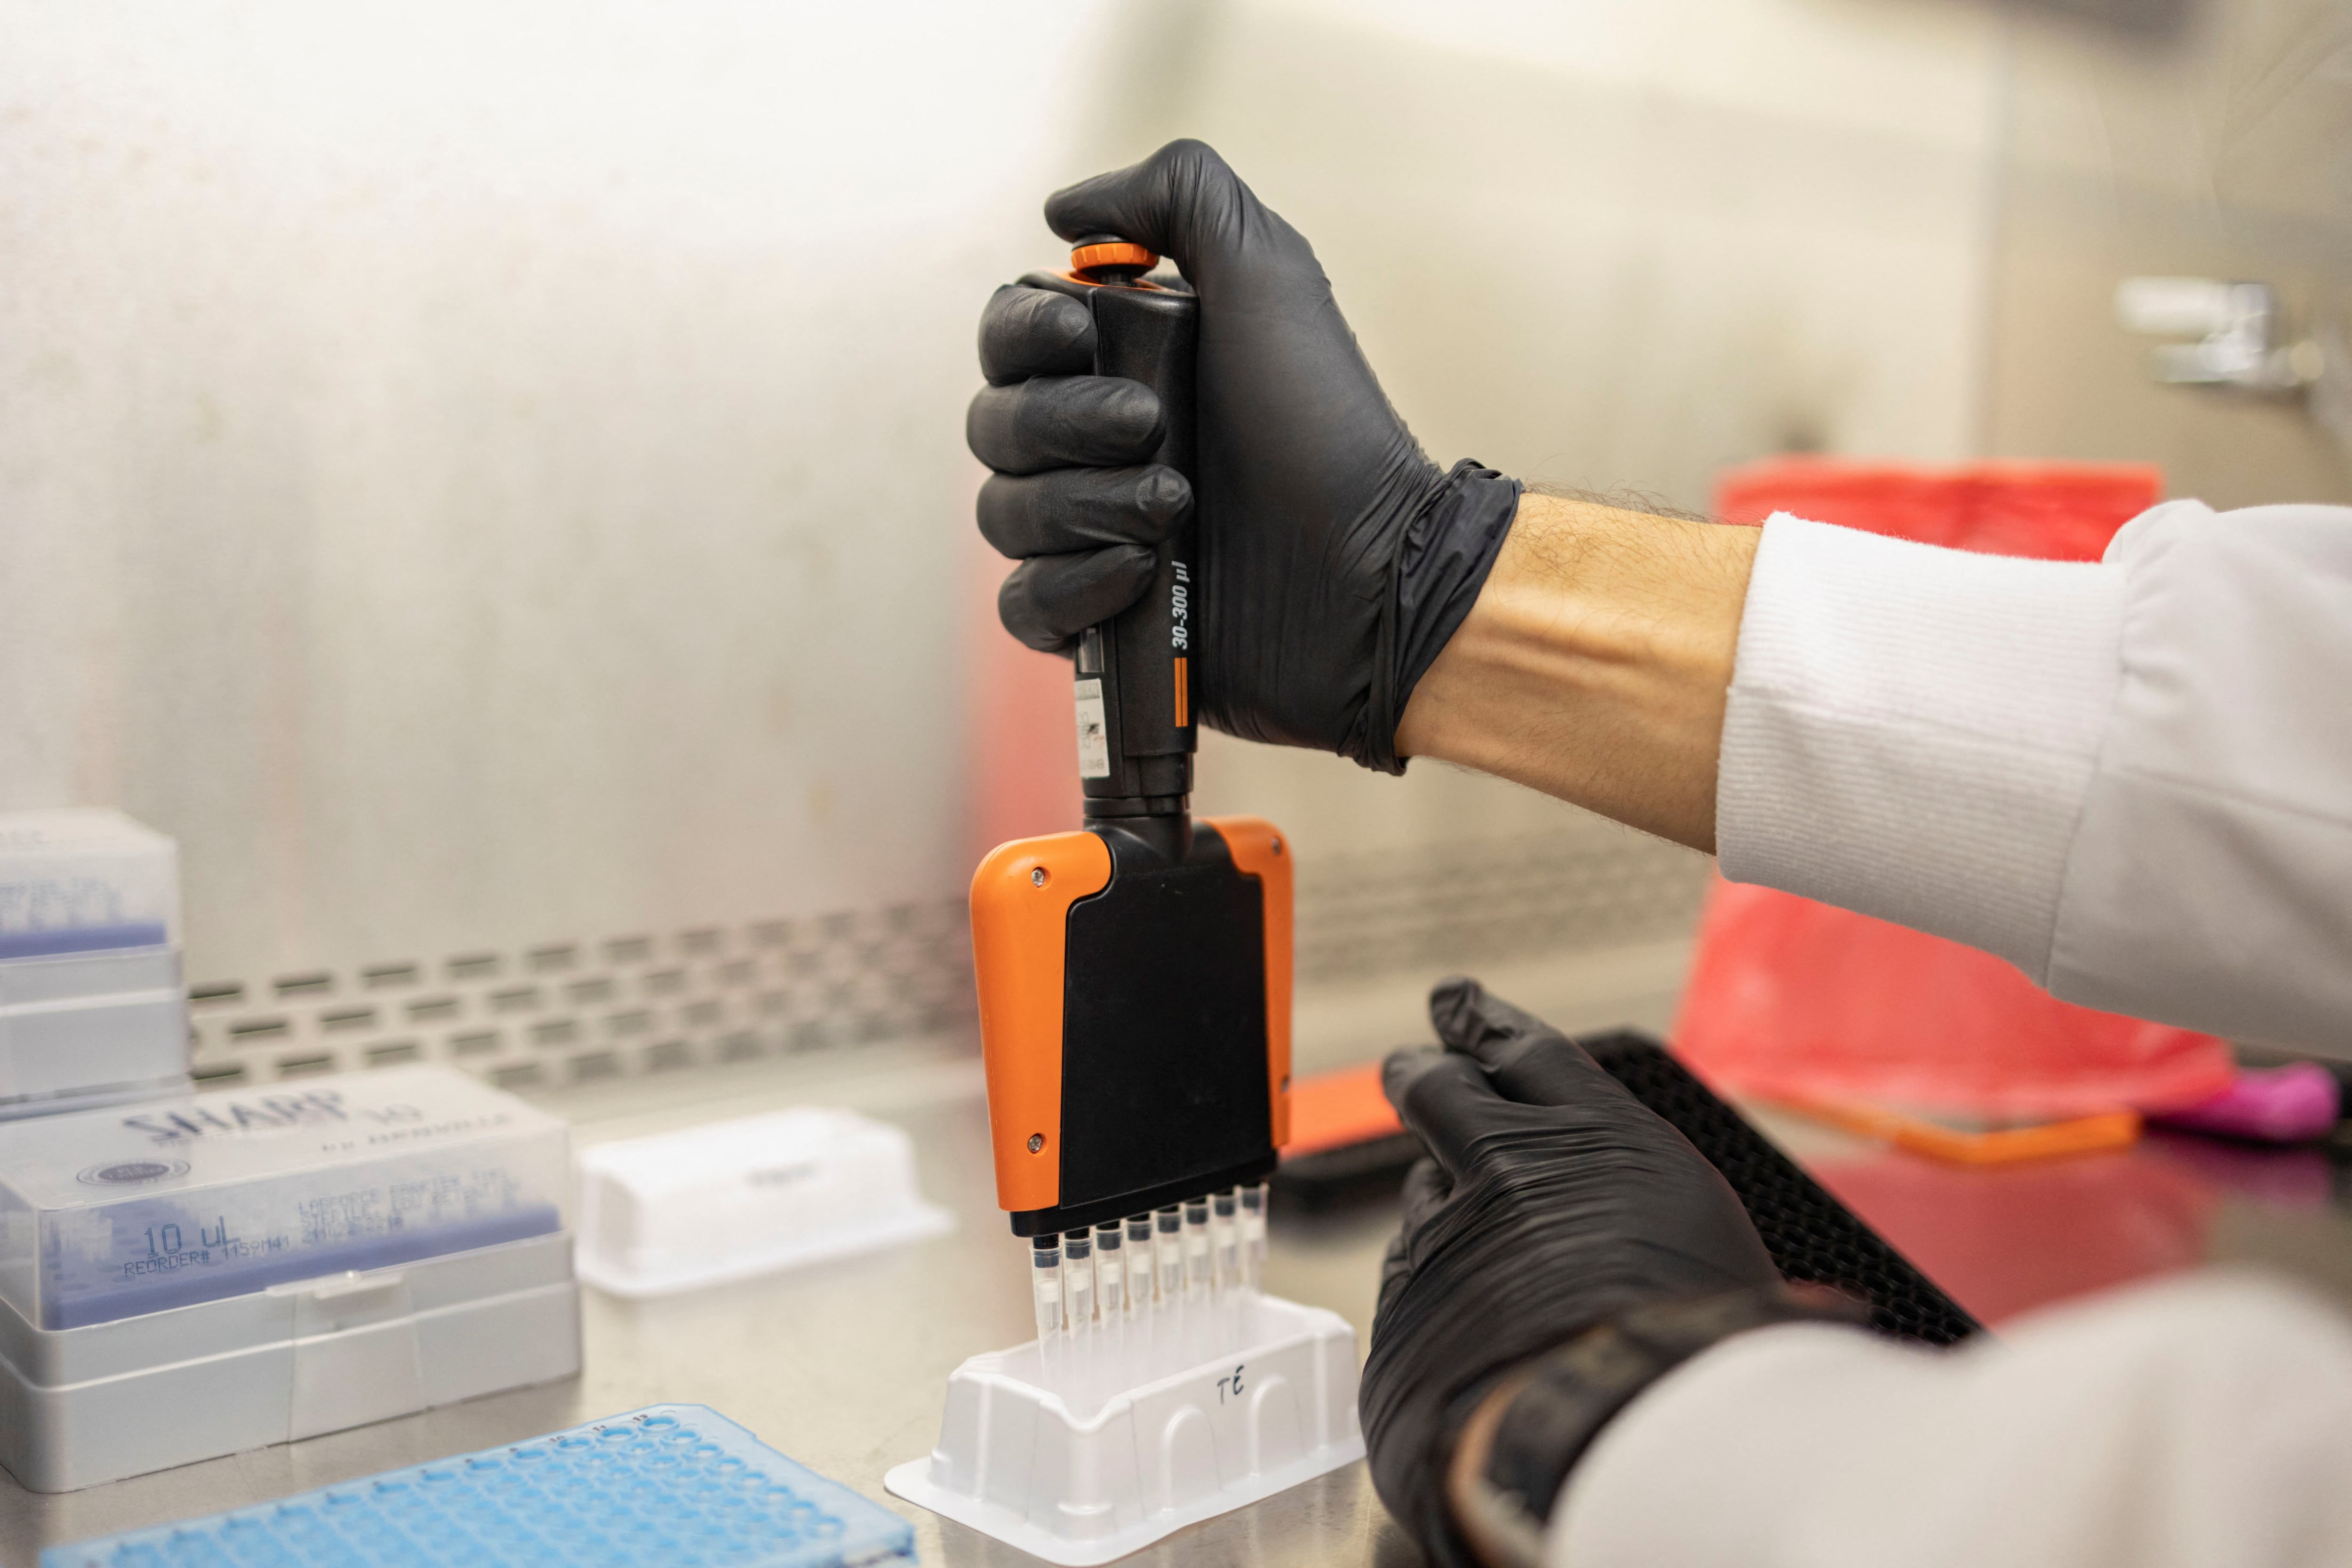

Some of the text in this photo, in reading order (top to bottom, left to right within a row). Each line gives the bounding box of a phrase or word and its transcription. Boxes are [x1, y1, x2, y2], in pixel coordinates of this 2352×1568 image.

[1172, 585, 1188, 650] 30-300
[144, 1215, 241, 1259] 10 uL
[124, 1250, 210, 1277] REORDER#
